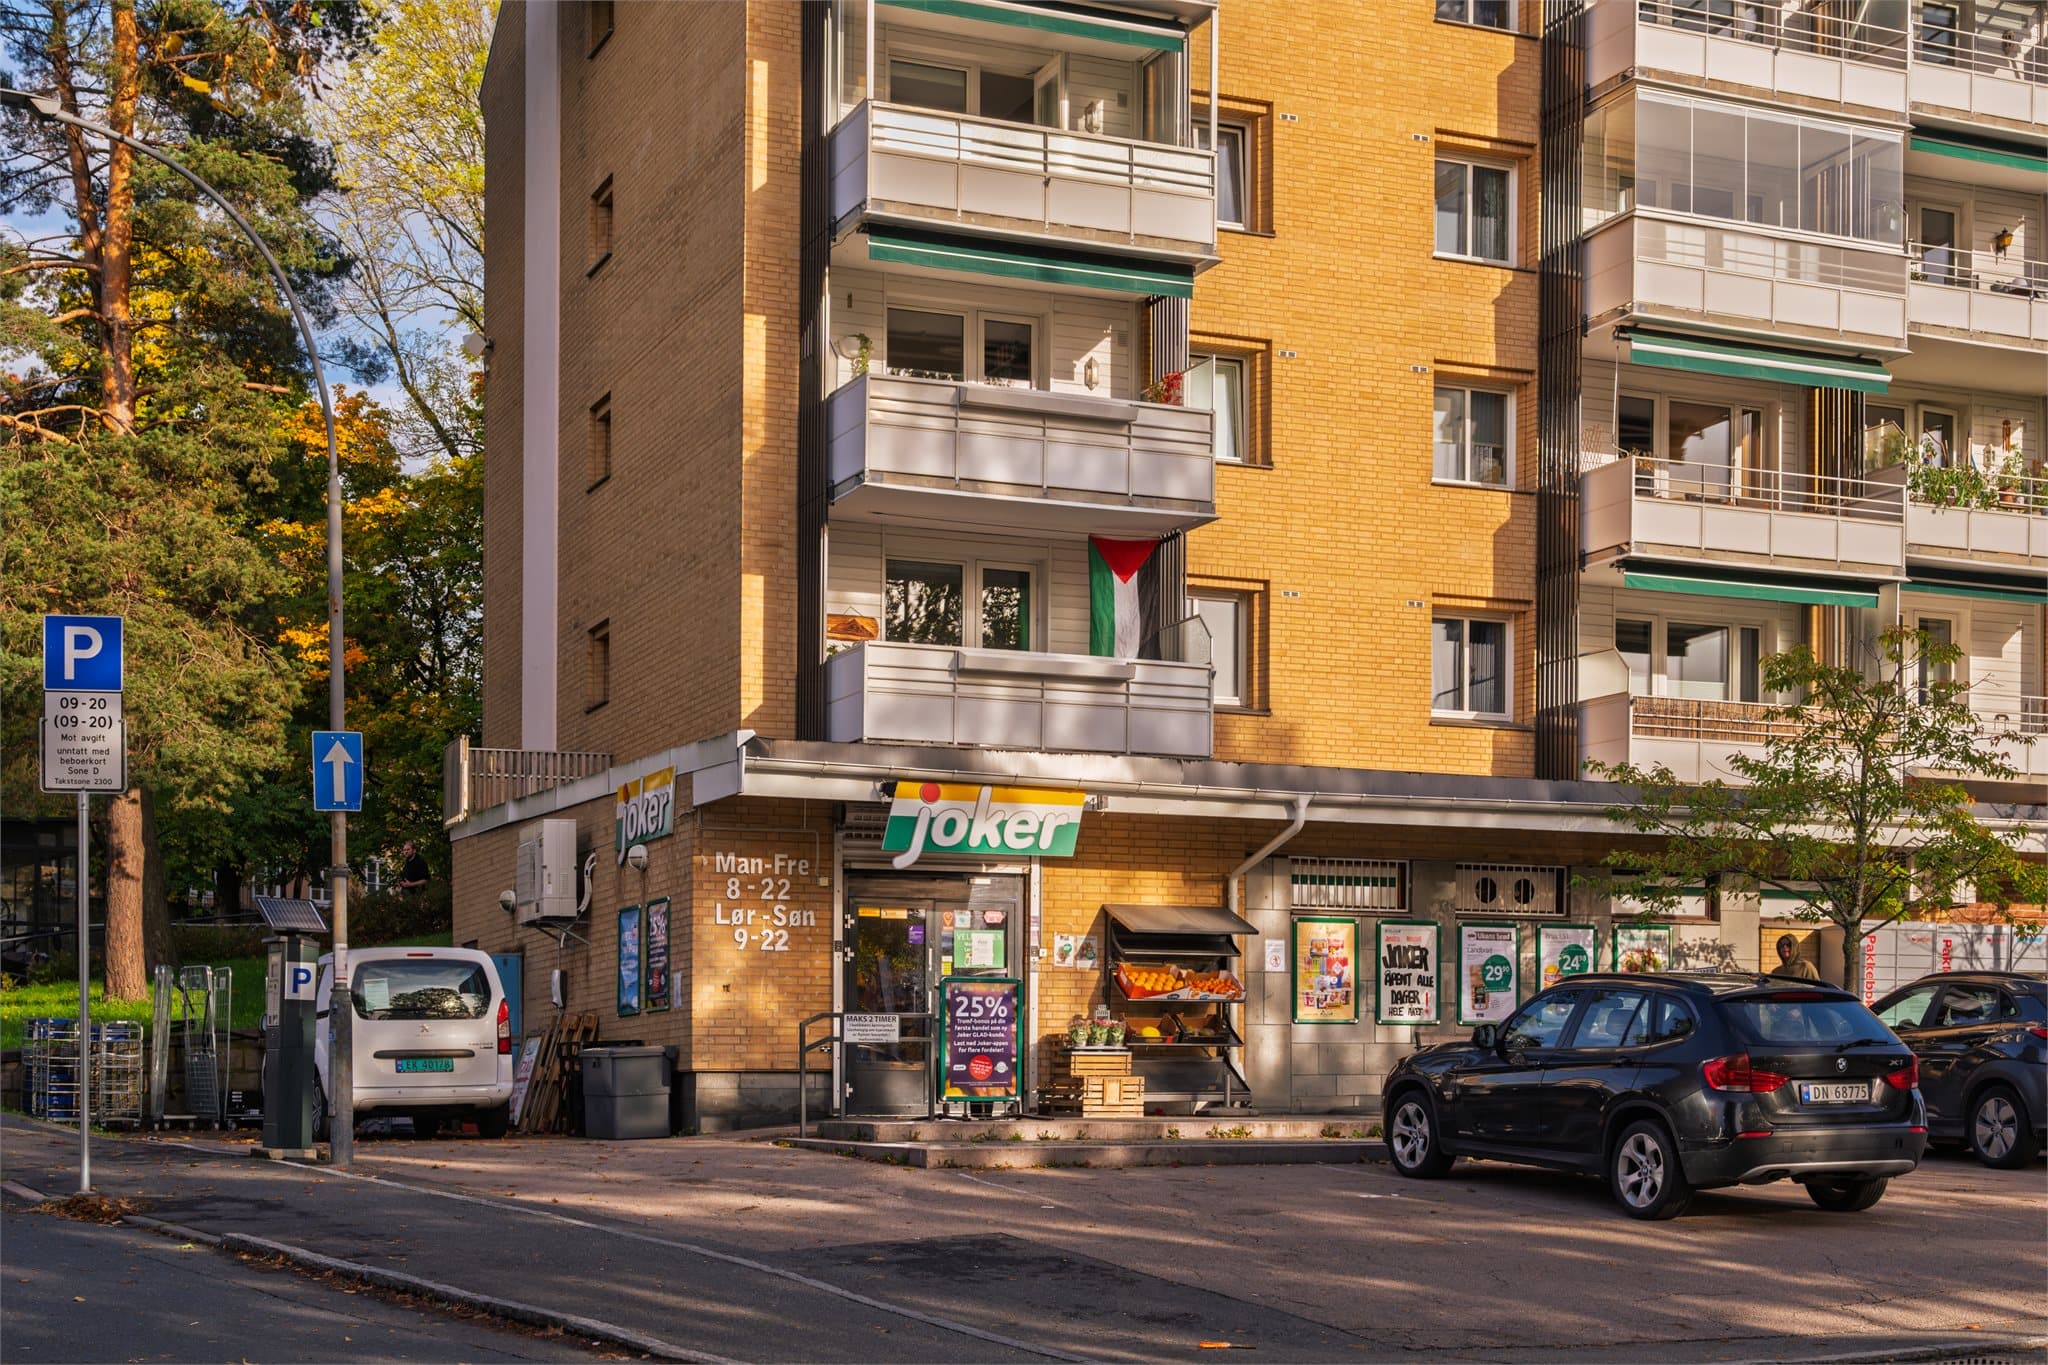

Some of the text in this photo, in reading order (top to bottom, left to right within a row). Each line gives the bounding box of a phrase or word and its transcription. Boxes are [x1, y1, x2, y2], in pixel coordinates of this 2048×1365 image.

[64, 626, 103, 680] P
[60, 697, 107, 710] 09-20
[61, 734, 106, 743] Mot avgift
[60, 757, 107, 765] beboerkort
[68, 767, 99, 775] Sone D
[618, 776, 669, 865] joker
[892, 782, 1071, 870] joker
[715, 852, 809, 875] Man-Fre
[1864, 935, 1877, 1007] Pakkebok
[292, 967, 312, 993] P
[1417, 975, 1434, 987] ALLE
[1391, 990, 1421, 1004] DAGER
[955, 996, 1008, 1017] 25%
[1389, 1007, 1404, 1016] HELE
[1813, 1084, 1867, 1099] DN 68775
